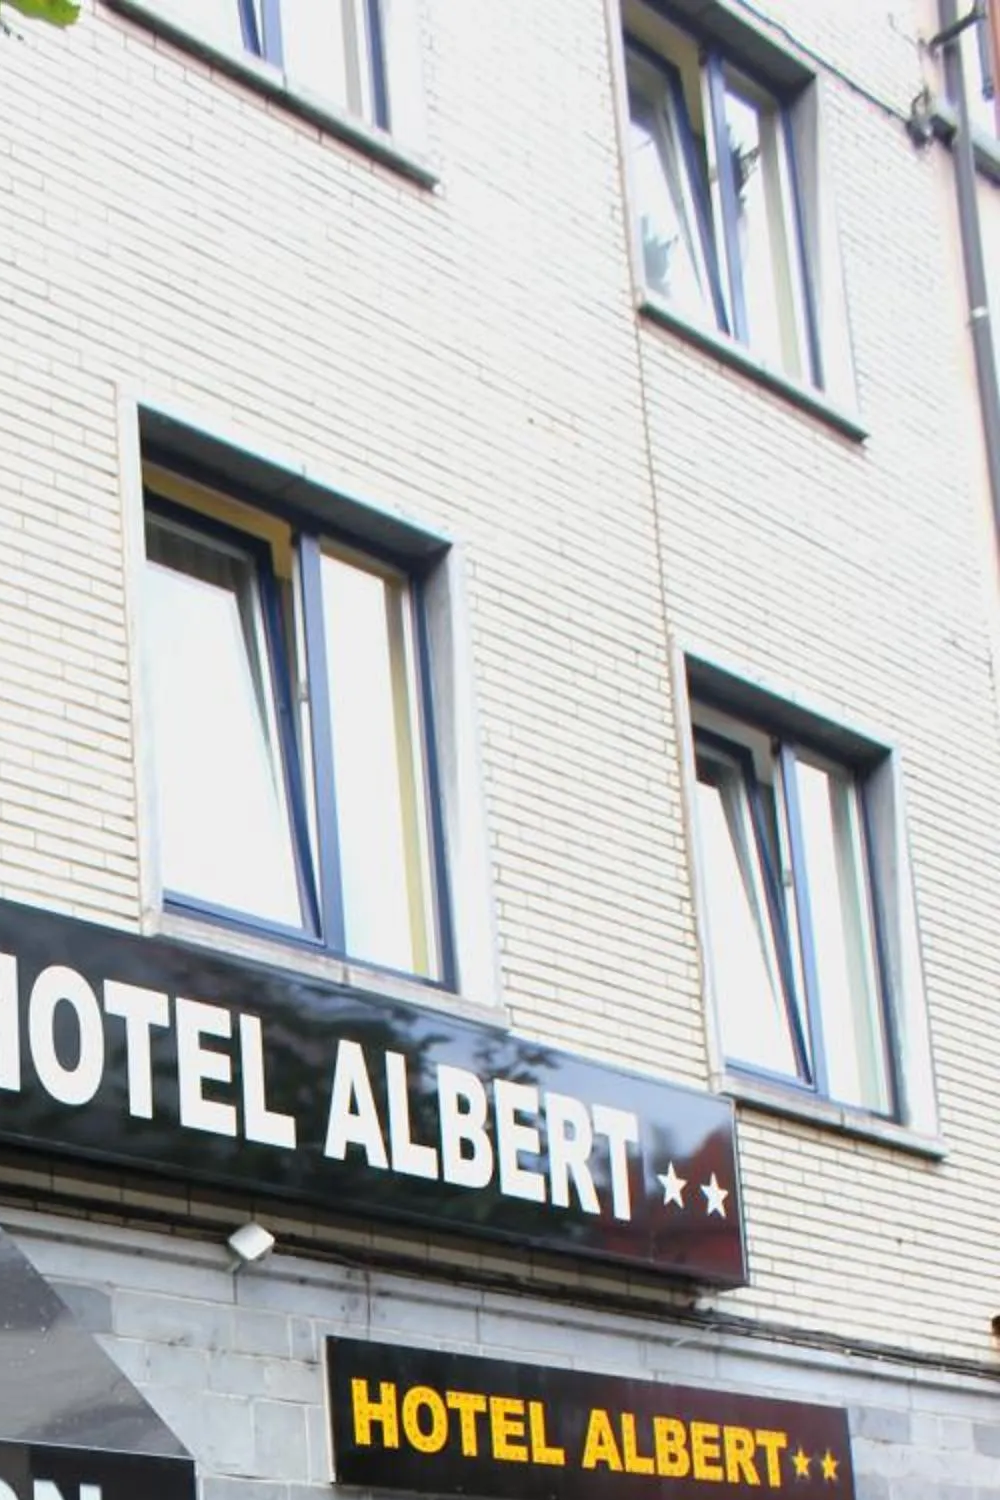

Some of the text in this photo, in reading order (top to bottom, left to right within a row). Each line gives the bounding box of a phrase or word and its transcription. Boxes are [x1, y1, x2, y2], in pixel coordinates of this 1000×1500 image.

[324, 1038, 639, 1222] ALBERT
[351, 1377, 788, 1488] HOTEL ALBERT
